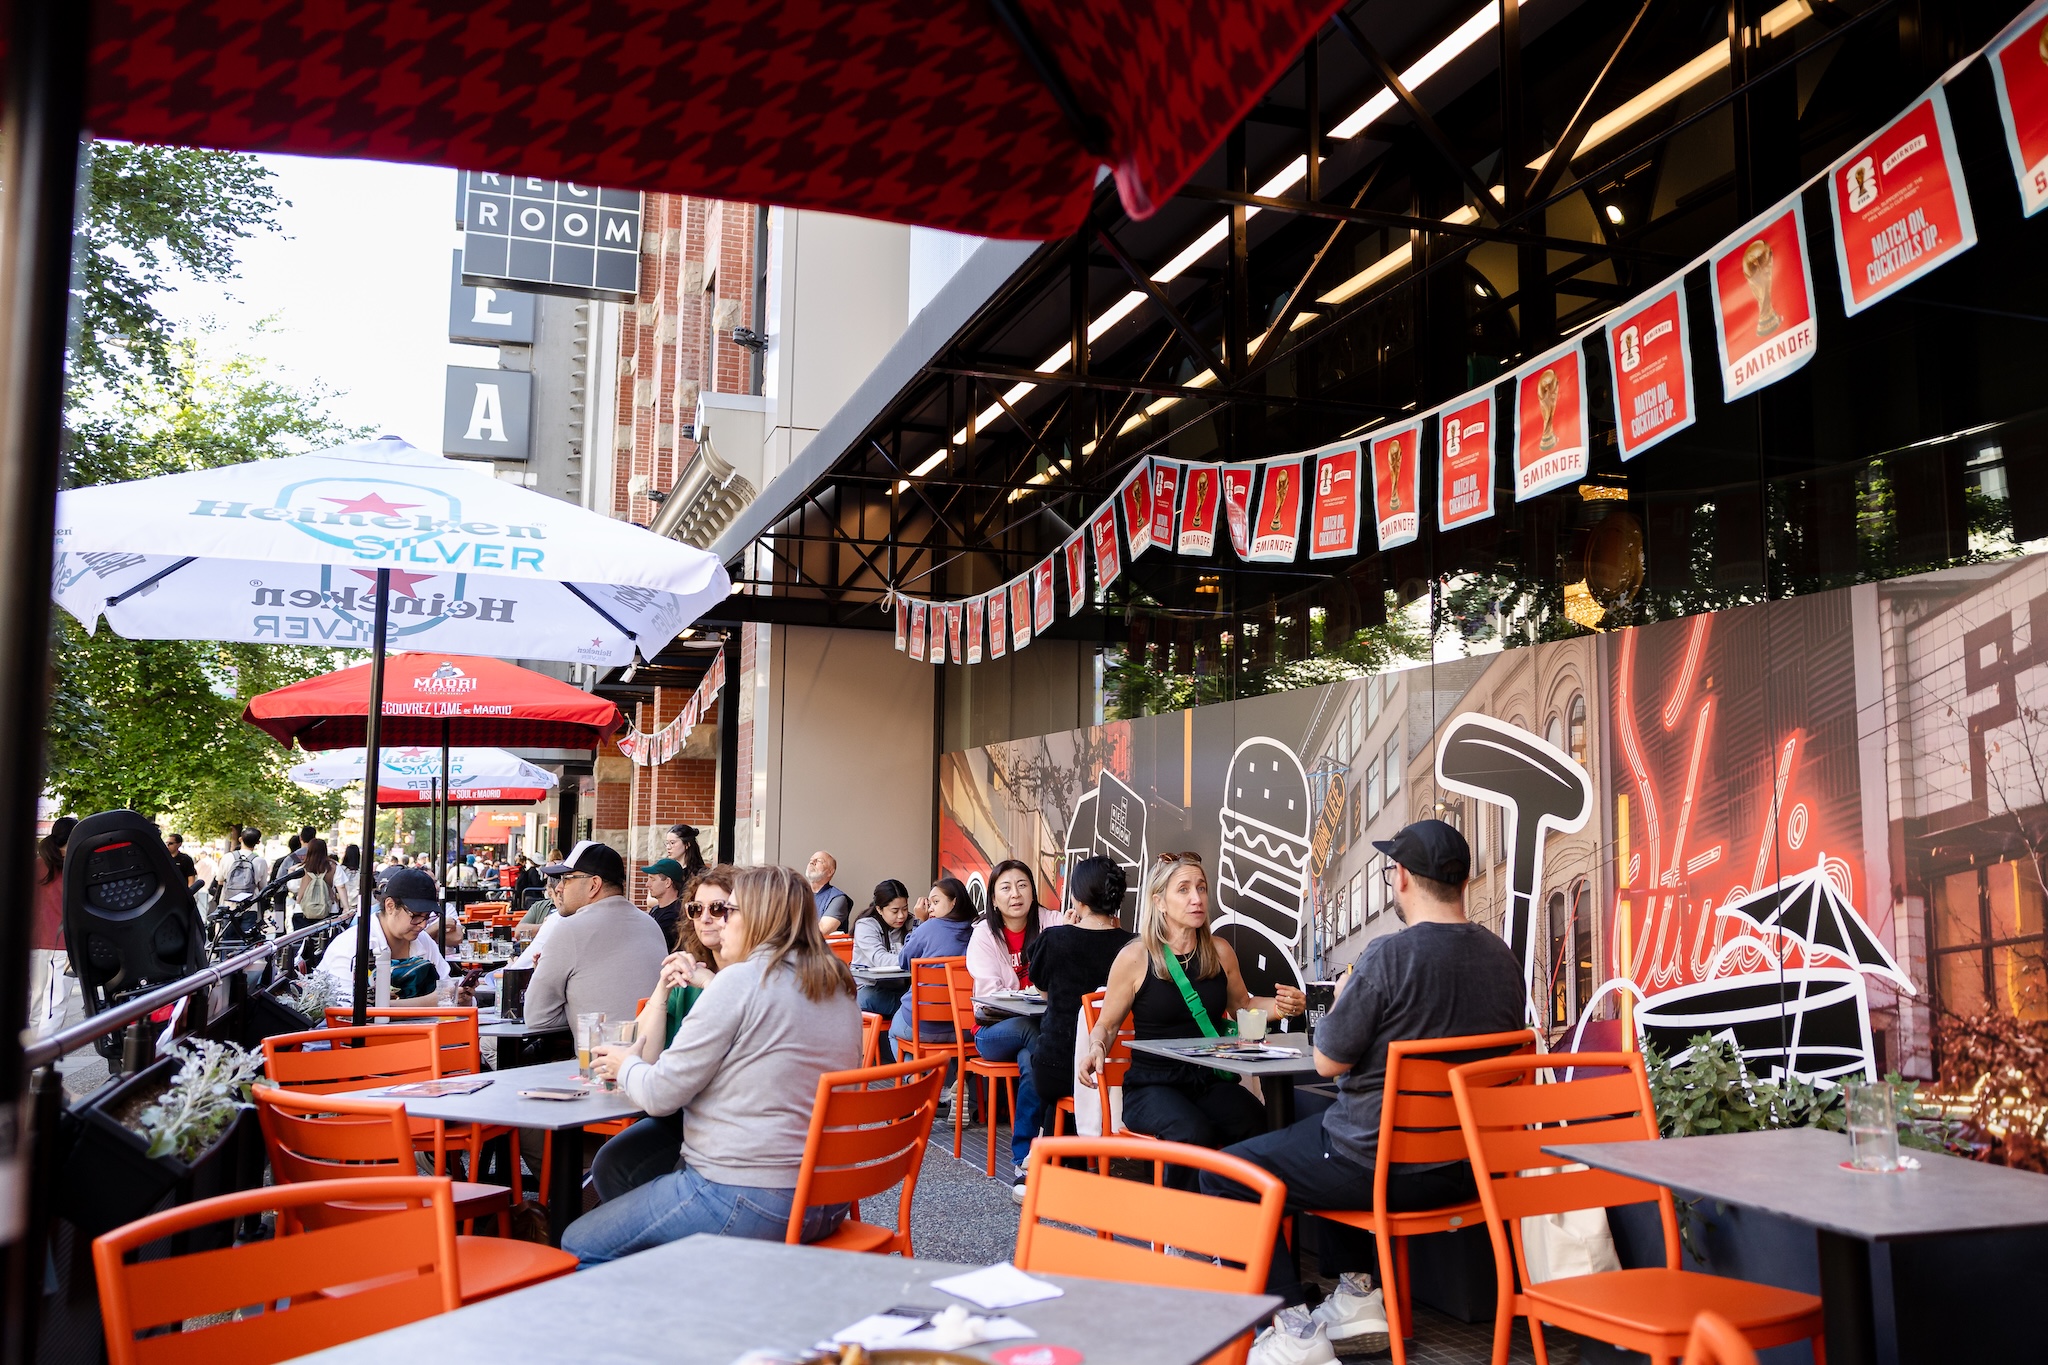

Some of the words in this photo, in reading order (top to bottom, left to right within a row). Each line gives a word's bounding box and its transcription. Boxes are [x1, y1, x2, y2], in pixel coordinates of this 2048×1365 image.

[1885, 138, 1923, 168] SMIRNOFF
[1858, 195, 1871, 206] FIFA
[478, 201, 631, 243] ROOM
[1871, 218, 1909, 258] MATCH
[1908, 207, 1929, 235] ON.
[1866, 234, 1922, 285] COCKTAILS
[1922, 224, 1943, 251] UP.
[1735, 328, 1810, 386] SMIRNOFF
[1634, 386, 1657, 416] MATCH
[1657, 381, 1669, 404] ON.
[1631, 404, 1664, 439] COCKTAILS
[1664, 398, 1676, 420] UP.
[1523, 454, 1580, 489] SMIRNOFF
[189, 499, 547, 539] Heineken
[1381, 518, 1414, 539] SMIRNOFF
[353, 535, 545, 572] SILVER
[1182, 534, 1210, 548] SMIRNOFF
[1255, 539, 1292, 553] SMIRNOFF
[382, 701, 431, 714] ÉCOUVREZ
[473, 704, 512, 715] MADRID
[402, 764, 463, 775] SILVR
[457, 789, 471, 799] SOUL
[478, 789, 501, 799] MADRID
